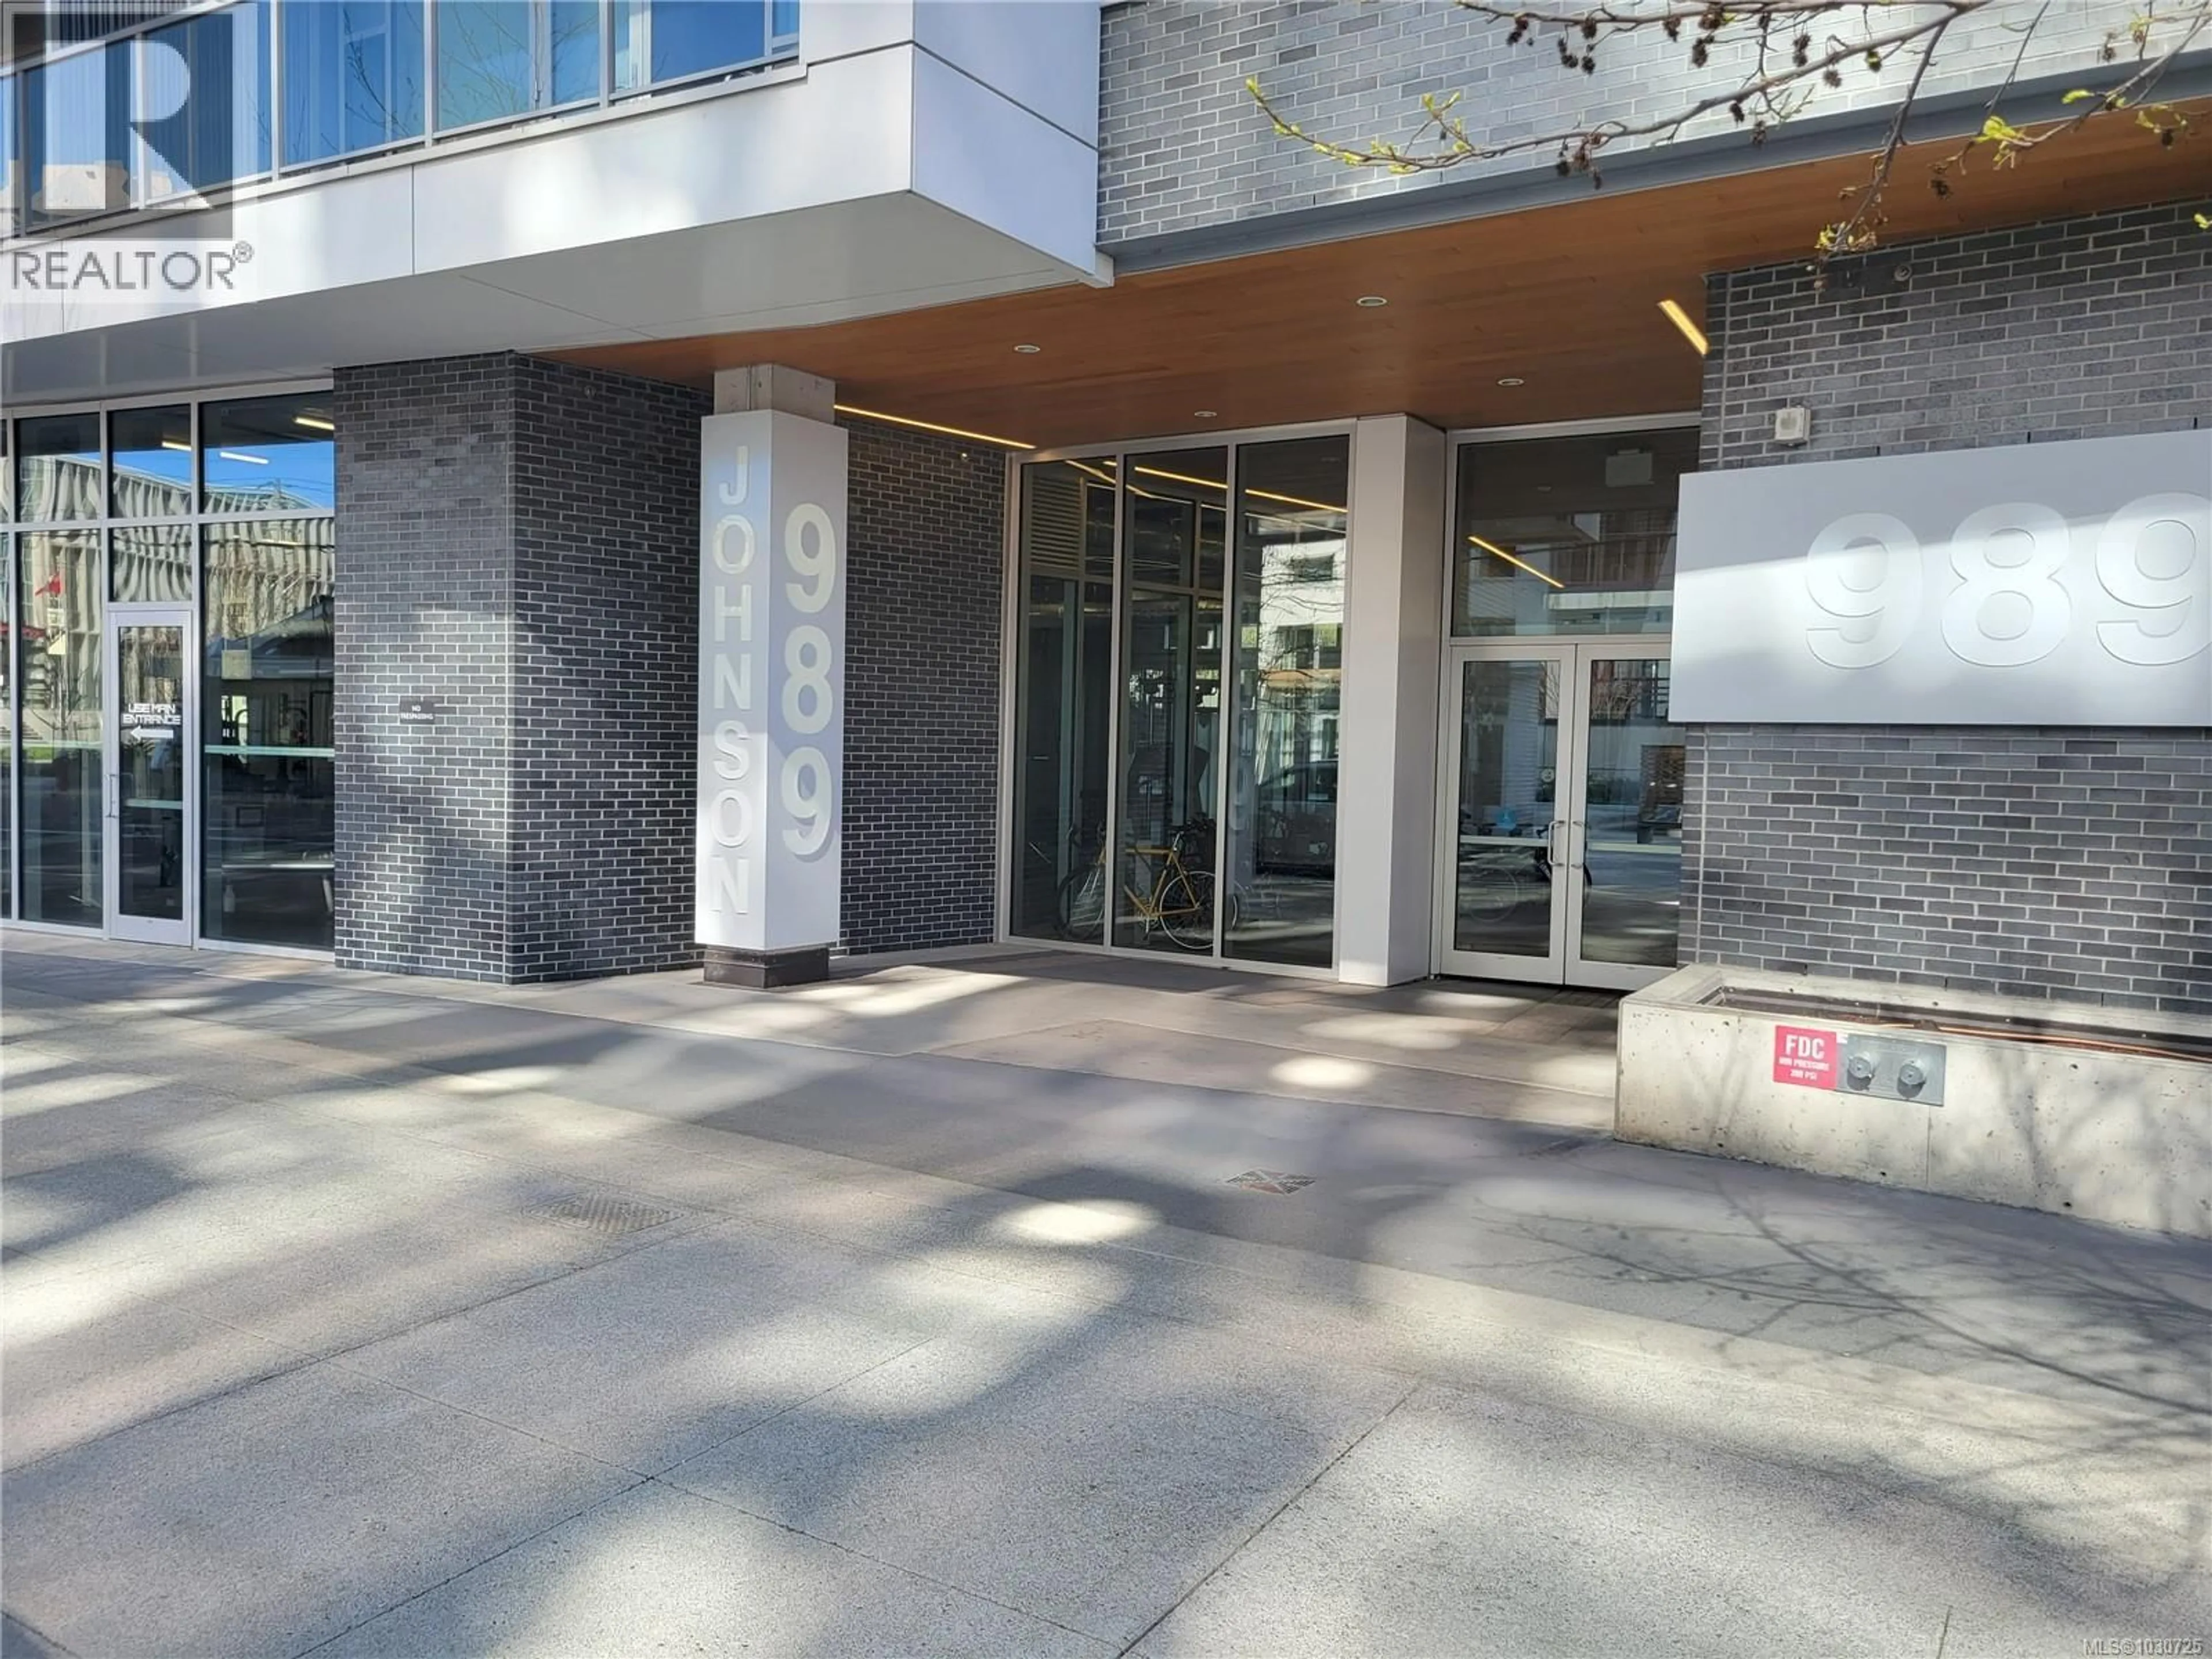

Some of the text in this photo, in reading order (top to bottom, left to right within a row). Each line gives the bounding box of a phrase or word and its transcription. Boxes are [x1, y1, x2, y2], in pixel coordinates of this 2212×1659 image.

[1805, 493, 2212, 669] 989
[123, 713, 181, 725] ENTRANCE
[711, 445, 756, 915] JOHNSON
[781, 502, 836, 857] 989
[1786, 1034, 1825, 1060] FDC
